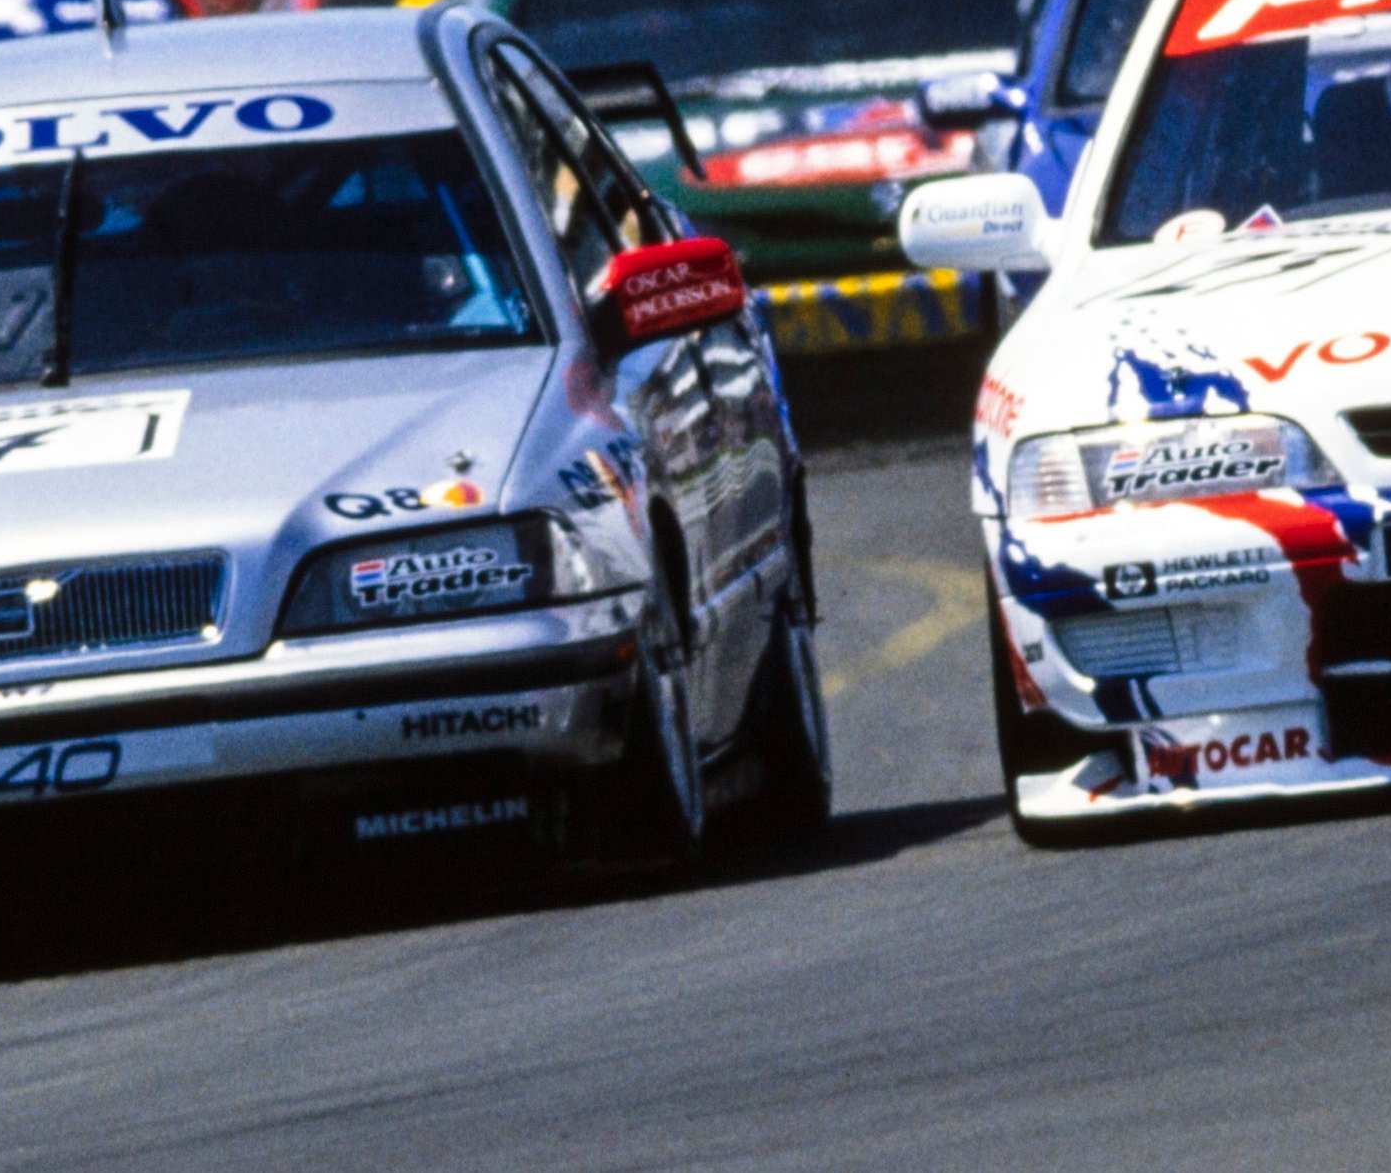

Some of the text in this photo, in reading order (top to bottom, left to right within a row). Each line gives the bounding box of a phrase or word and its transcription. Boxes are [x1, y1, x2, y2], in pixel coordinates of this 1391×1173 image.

[927, 201, 1024, 224] Guardian
[625, 261, 690, 296] OSCAR
[1142, 440, 1251, 466] Auto
[1108, 457, 1282, 494] Trader
[323, 486, 431, 521] Q8
[388, 548, 495, 577] Auto
[1163, 545, 1266, 574] HEWLETT
[356, 566, 531, 605] Trader
[1165, 568, 1271, 594] PACKARD
[401, 704, 541, 740] HITACHI
[1150, 728, 1310, 777] AUTOCAR
[355, 796, 530, 843] MICHELIN
